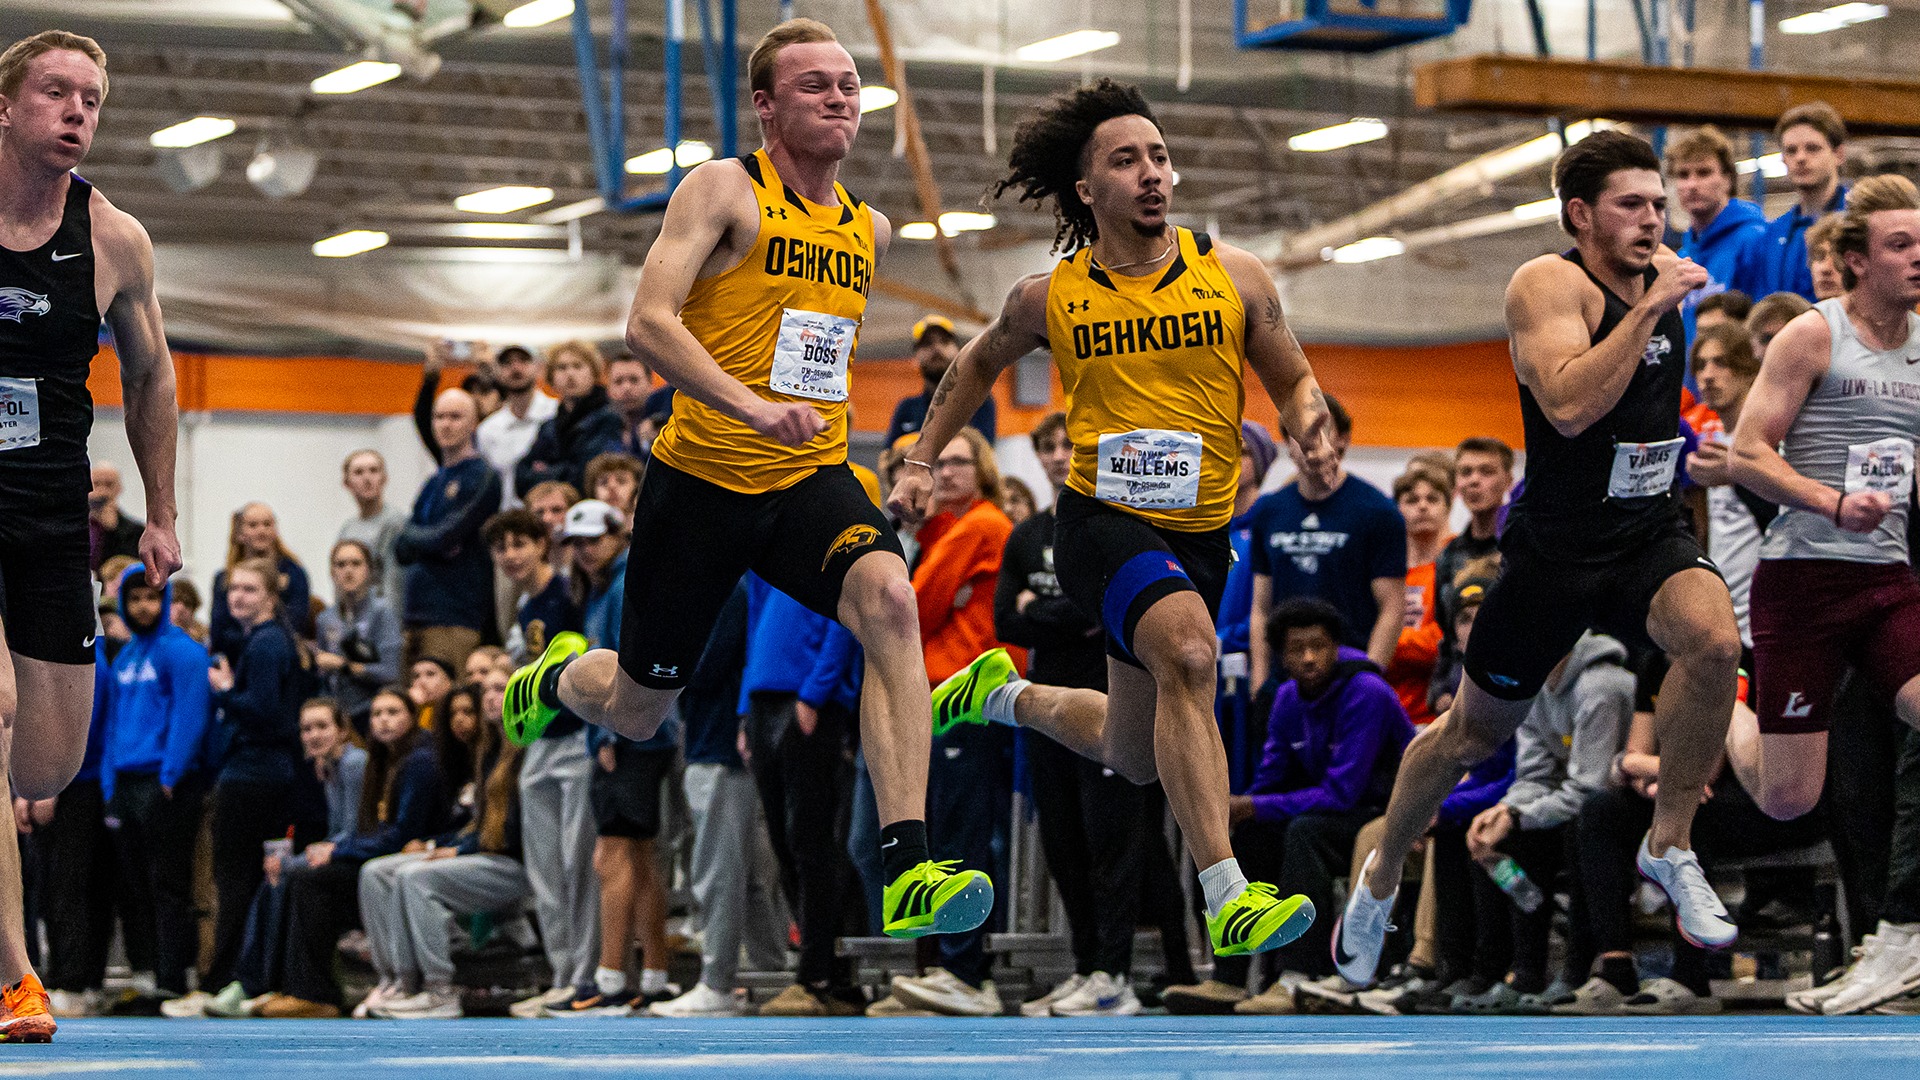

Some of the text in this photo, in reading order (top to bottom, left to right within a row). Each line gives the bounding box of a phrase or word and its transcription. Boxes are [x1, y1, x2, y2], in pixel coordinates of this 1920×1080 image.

[764, 236, 872, 300] OSHKOSH
[1072, 310, 1223, 360] OSHKOSH
[803, 344, 837, 365] DOSS
[1110, 457, 1189, 477] WILLEMS
